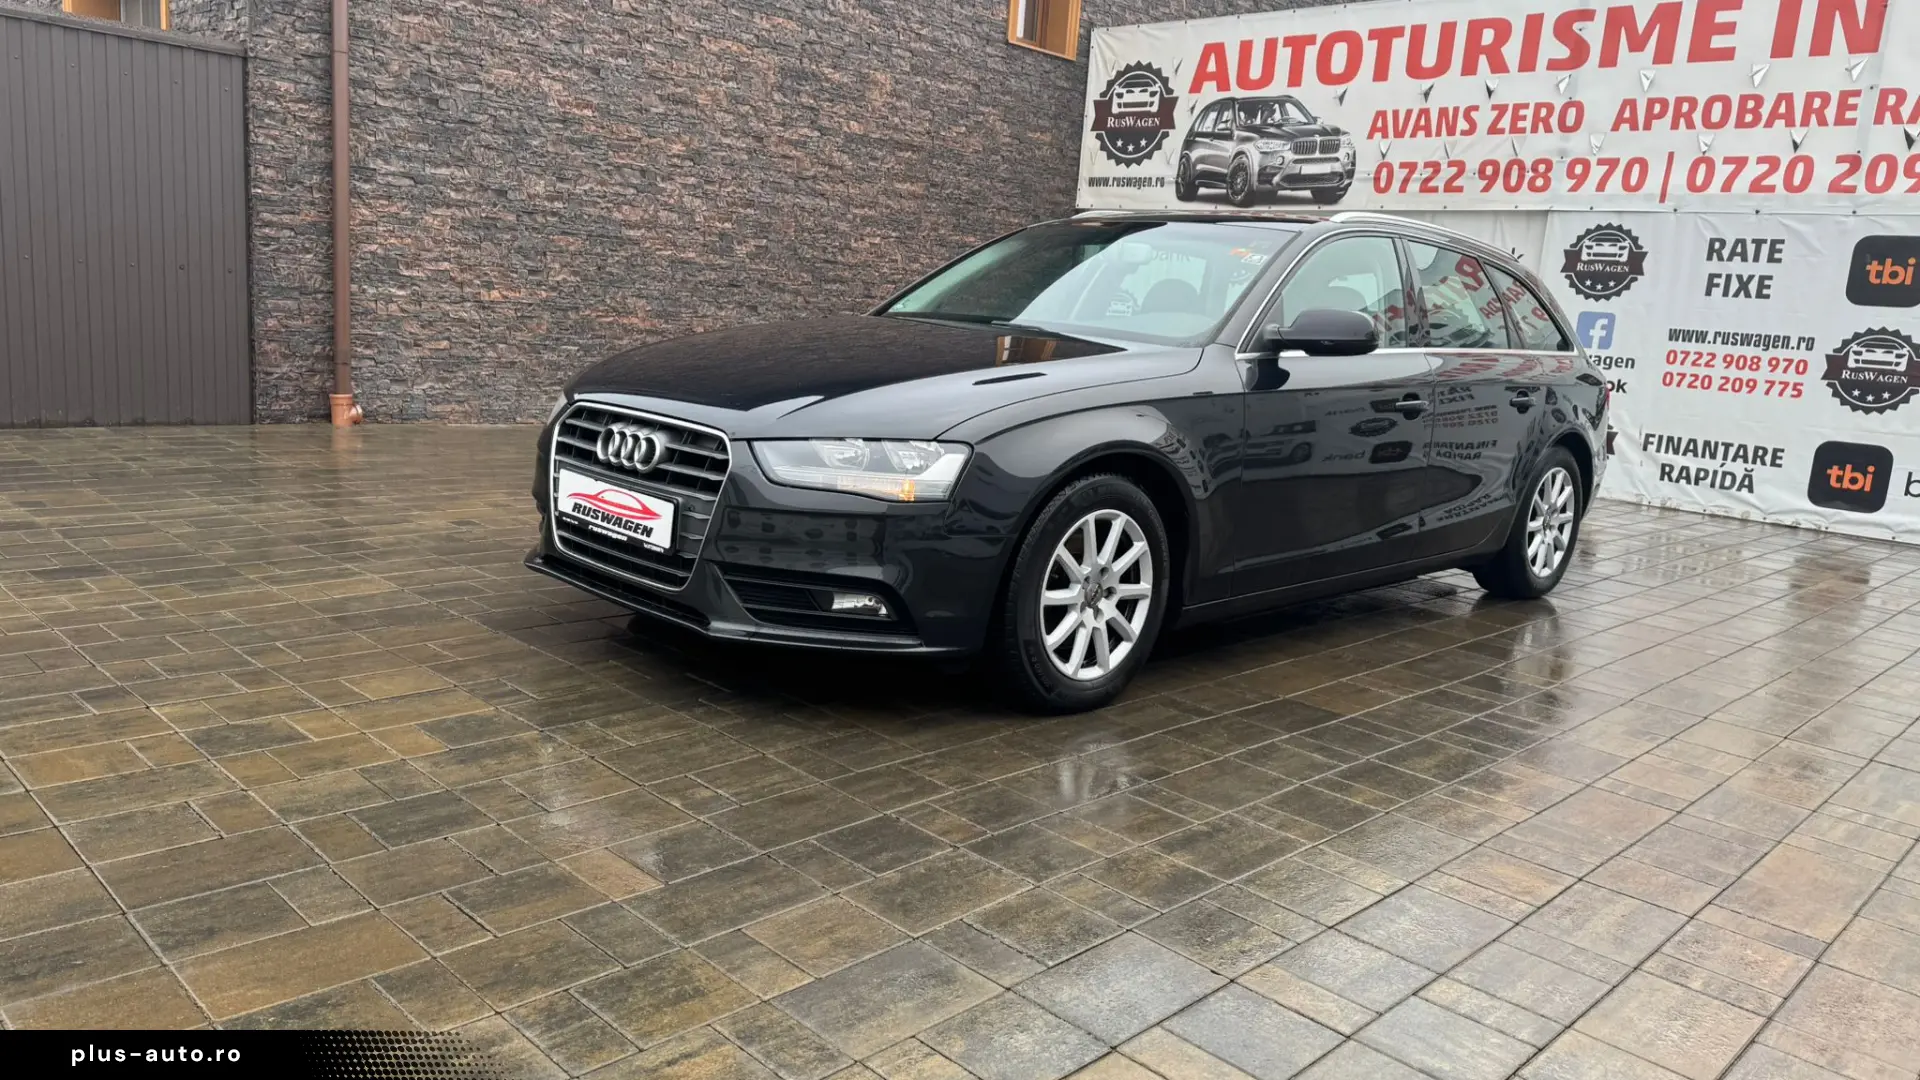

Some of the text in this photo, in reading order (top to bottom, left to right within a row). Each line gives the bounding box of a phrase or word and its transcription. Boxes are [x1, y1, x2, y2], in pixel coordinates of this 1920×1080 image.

[1188, 0, 1888, 94] AUTOTURISME IN
[1366, 104, 1480, 140] AVANS
[1487, 100, 1584, 135] ZERO
[1611, 89, 1862, 132] APROBARE
[1088, 176, 1165, 190] www.ruswagen.ro
[1373, 160, 1467, 194] 0722
[1478, 156, 1553, 193] 908
[1565, 156, 1649, 193] 970
[1686, 154, 1815, 193] 0720
[1705, 237, 1785, 264] RATE
[1865, 257, 1916, 286] tbi
[1704, 272, 1773, 300] FIXE
[1668, 328, 1815, 351] www.ruswagen.ro
[1665, 349, 1809, 375] 0722 908 970
[1662, 371, 1804, 398] 0720 209 775
[1659, 462, 1754, 494] RAPIDĂ
[1826, 464, 1876, 492] tbi
[571, 502, 654, 538] RUSWAGEN
